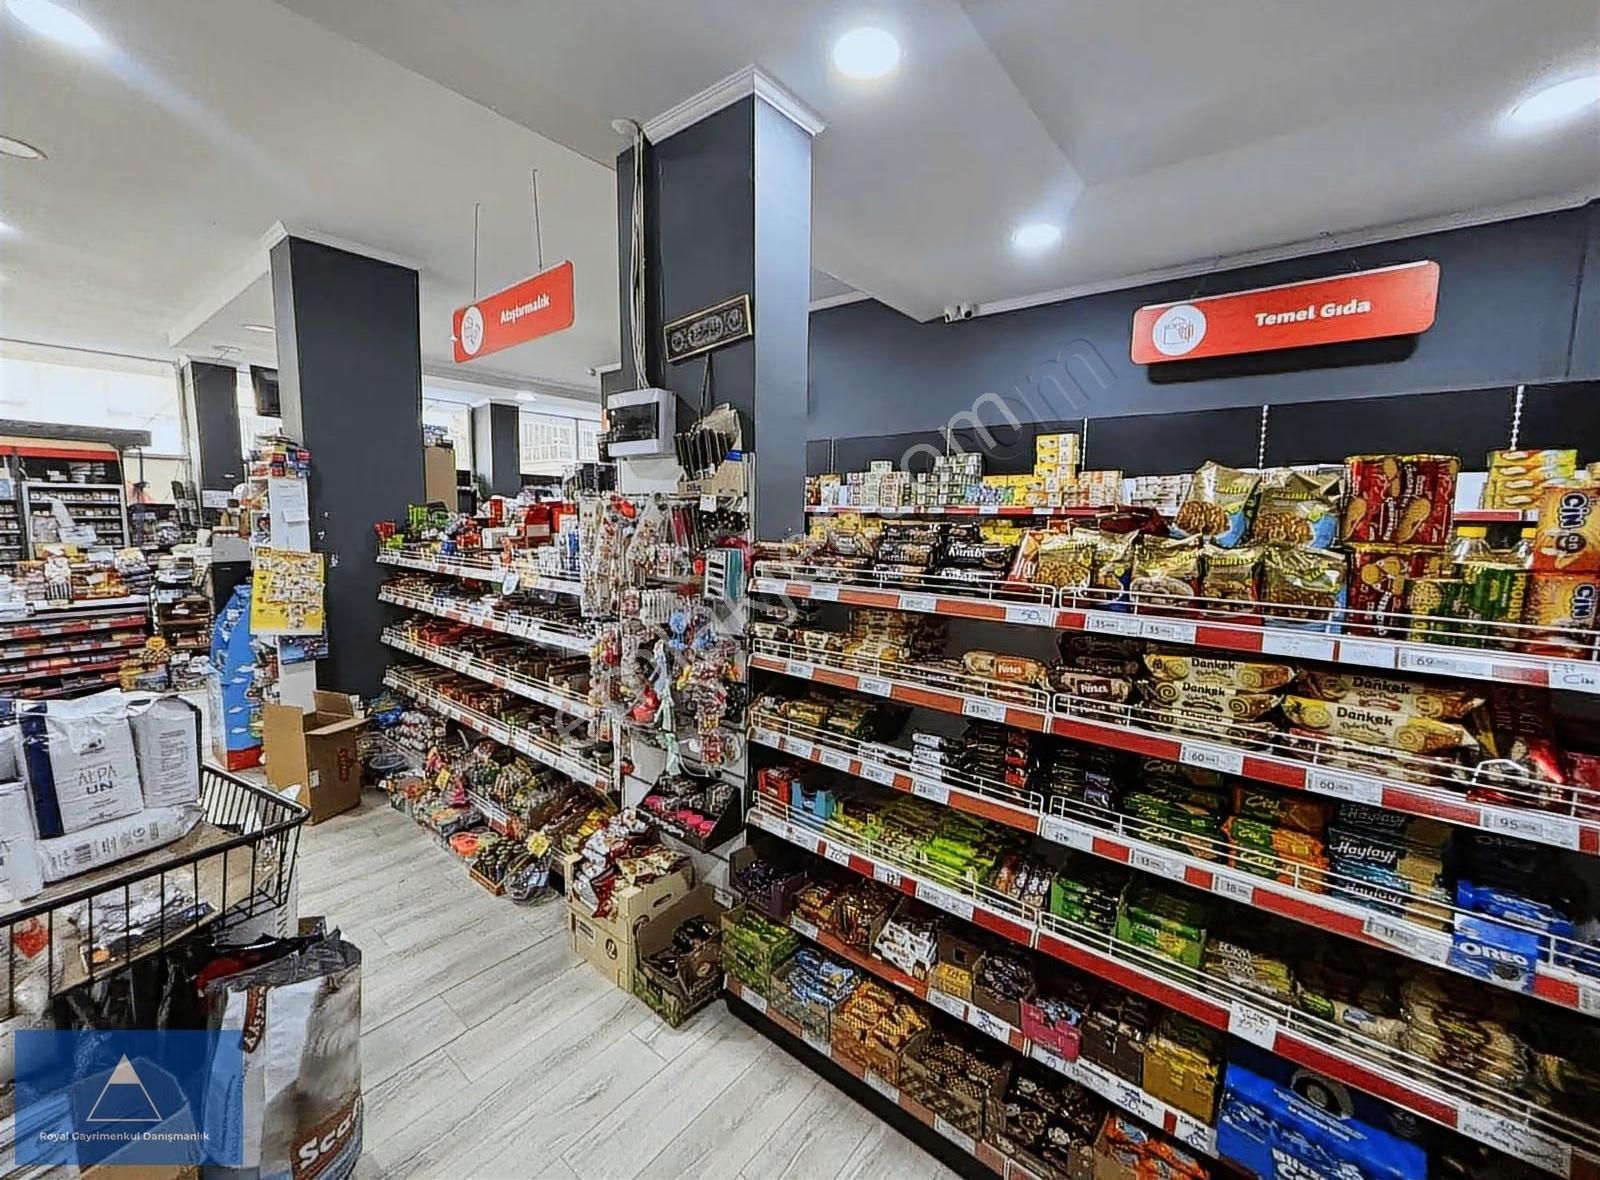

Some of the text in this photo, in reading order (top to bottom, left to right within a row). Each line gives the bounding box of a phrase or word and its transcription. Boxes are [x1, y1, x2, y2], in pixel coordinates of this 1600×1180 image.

[1254, 298, 1372, 328] Temel Gıda
[1191, 657, 1236, 671] Dankek
[1416, 656, 1434, 667] 69
[1182, 681, 1225, 697] Dankek
[1351, 676, 1412, 695] Dankek
[1336, 706, 1394, 727] Dankek
[1191, 752, 1205, 763] 60
[86, 780, 114, 795] UN
[1319, 779, 1336, 792] 60
[1500, 817, 1519, 830] 95
[1459, 942, 1530, 966] OREO
